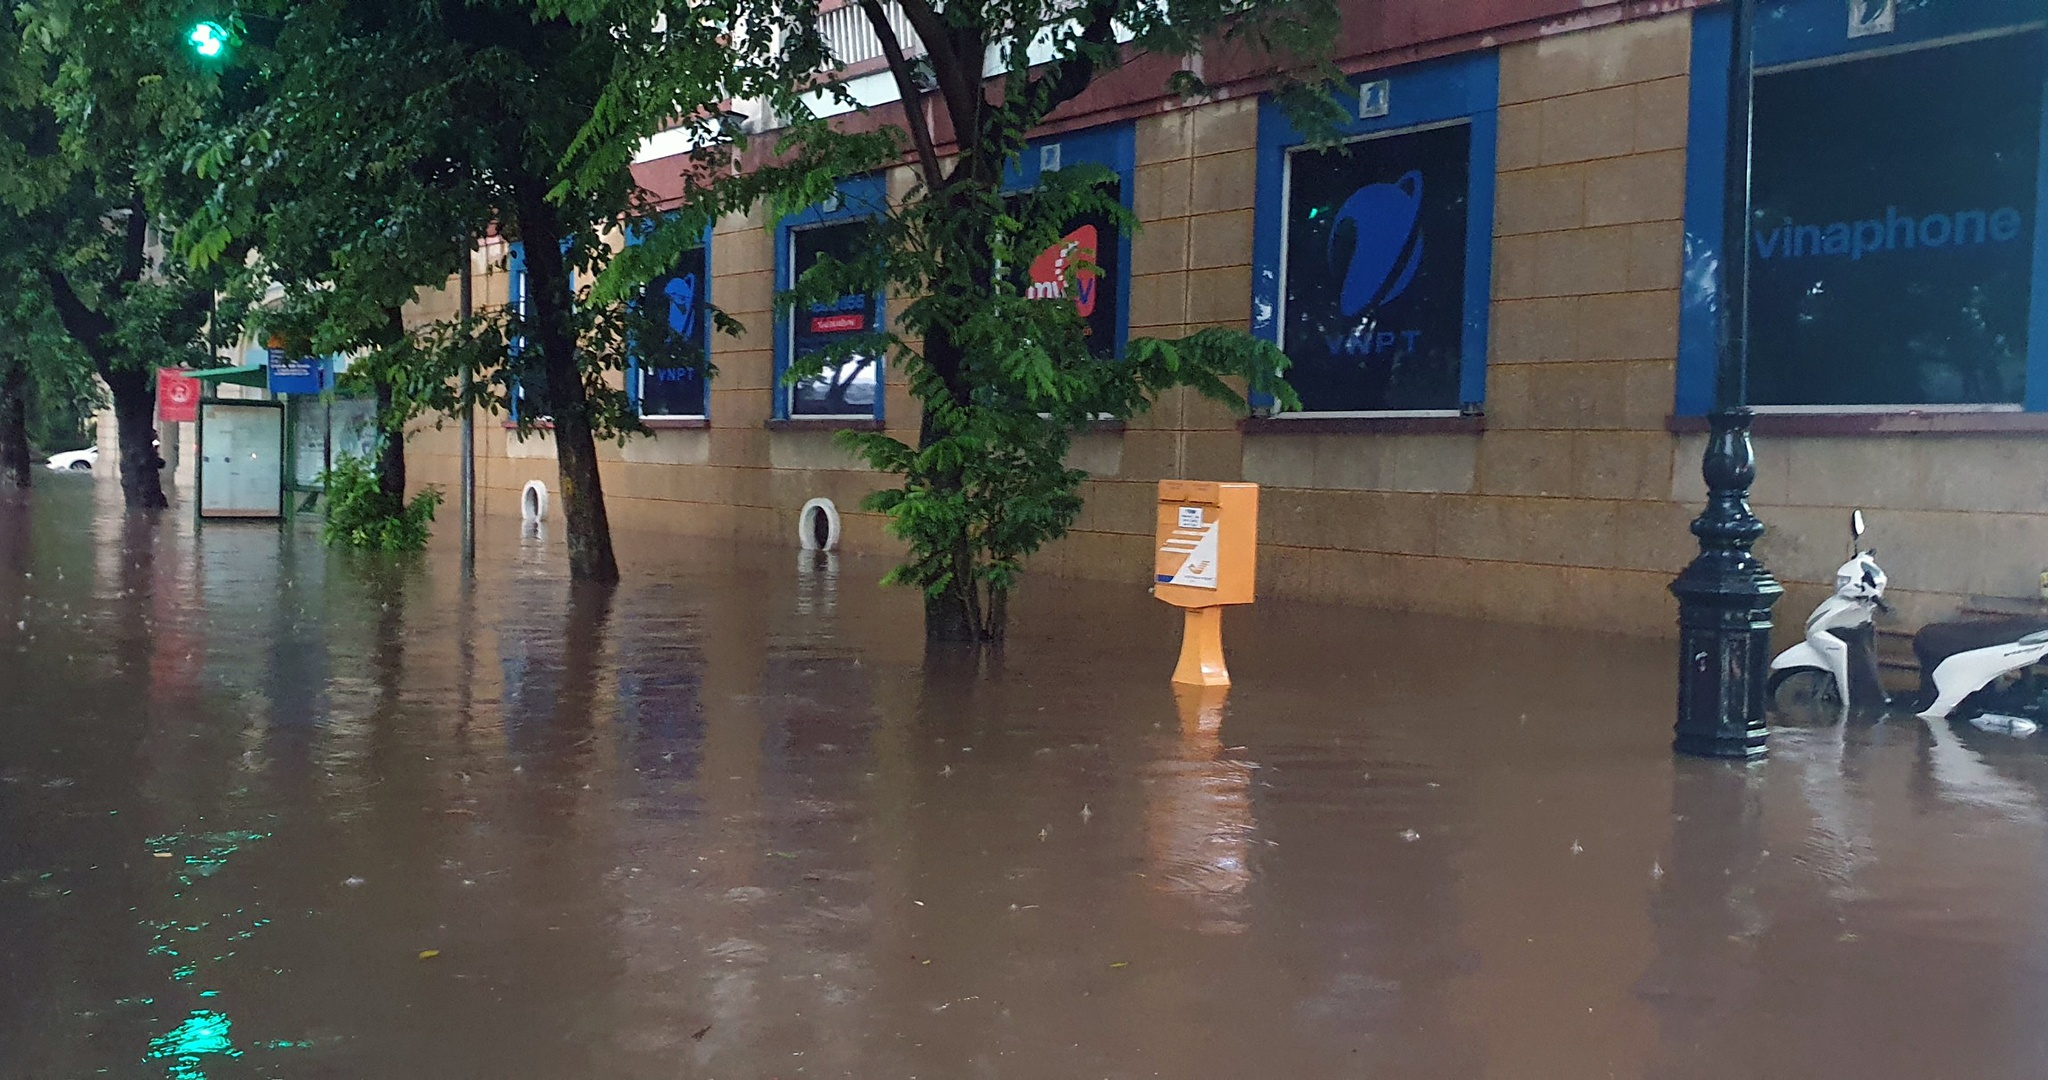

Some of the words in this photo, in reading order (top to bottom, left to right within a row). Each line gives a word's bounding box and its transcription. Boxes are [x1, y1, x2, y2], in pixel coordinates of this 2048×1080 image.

[1755, 206, 2021, 260] vinaphone
[1325, 330, 1421, 355] VNPT
[657, 367, 694, 381] VNPT
